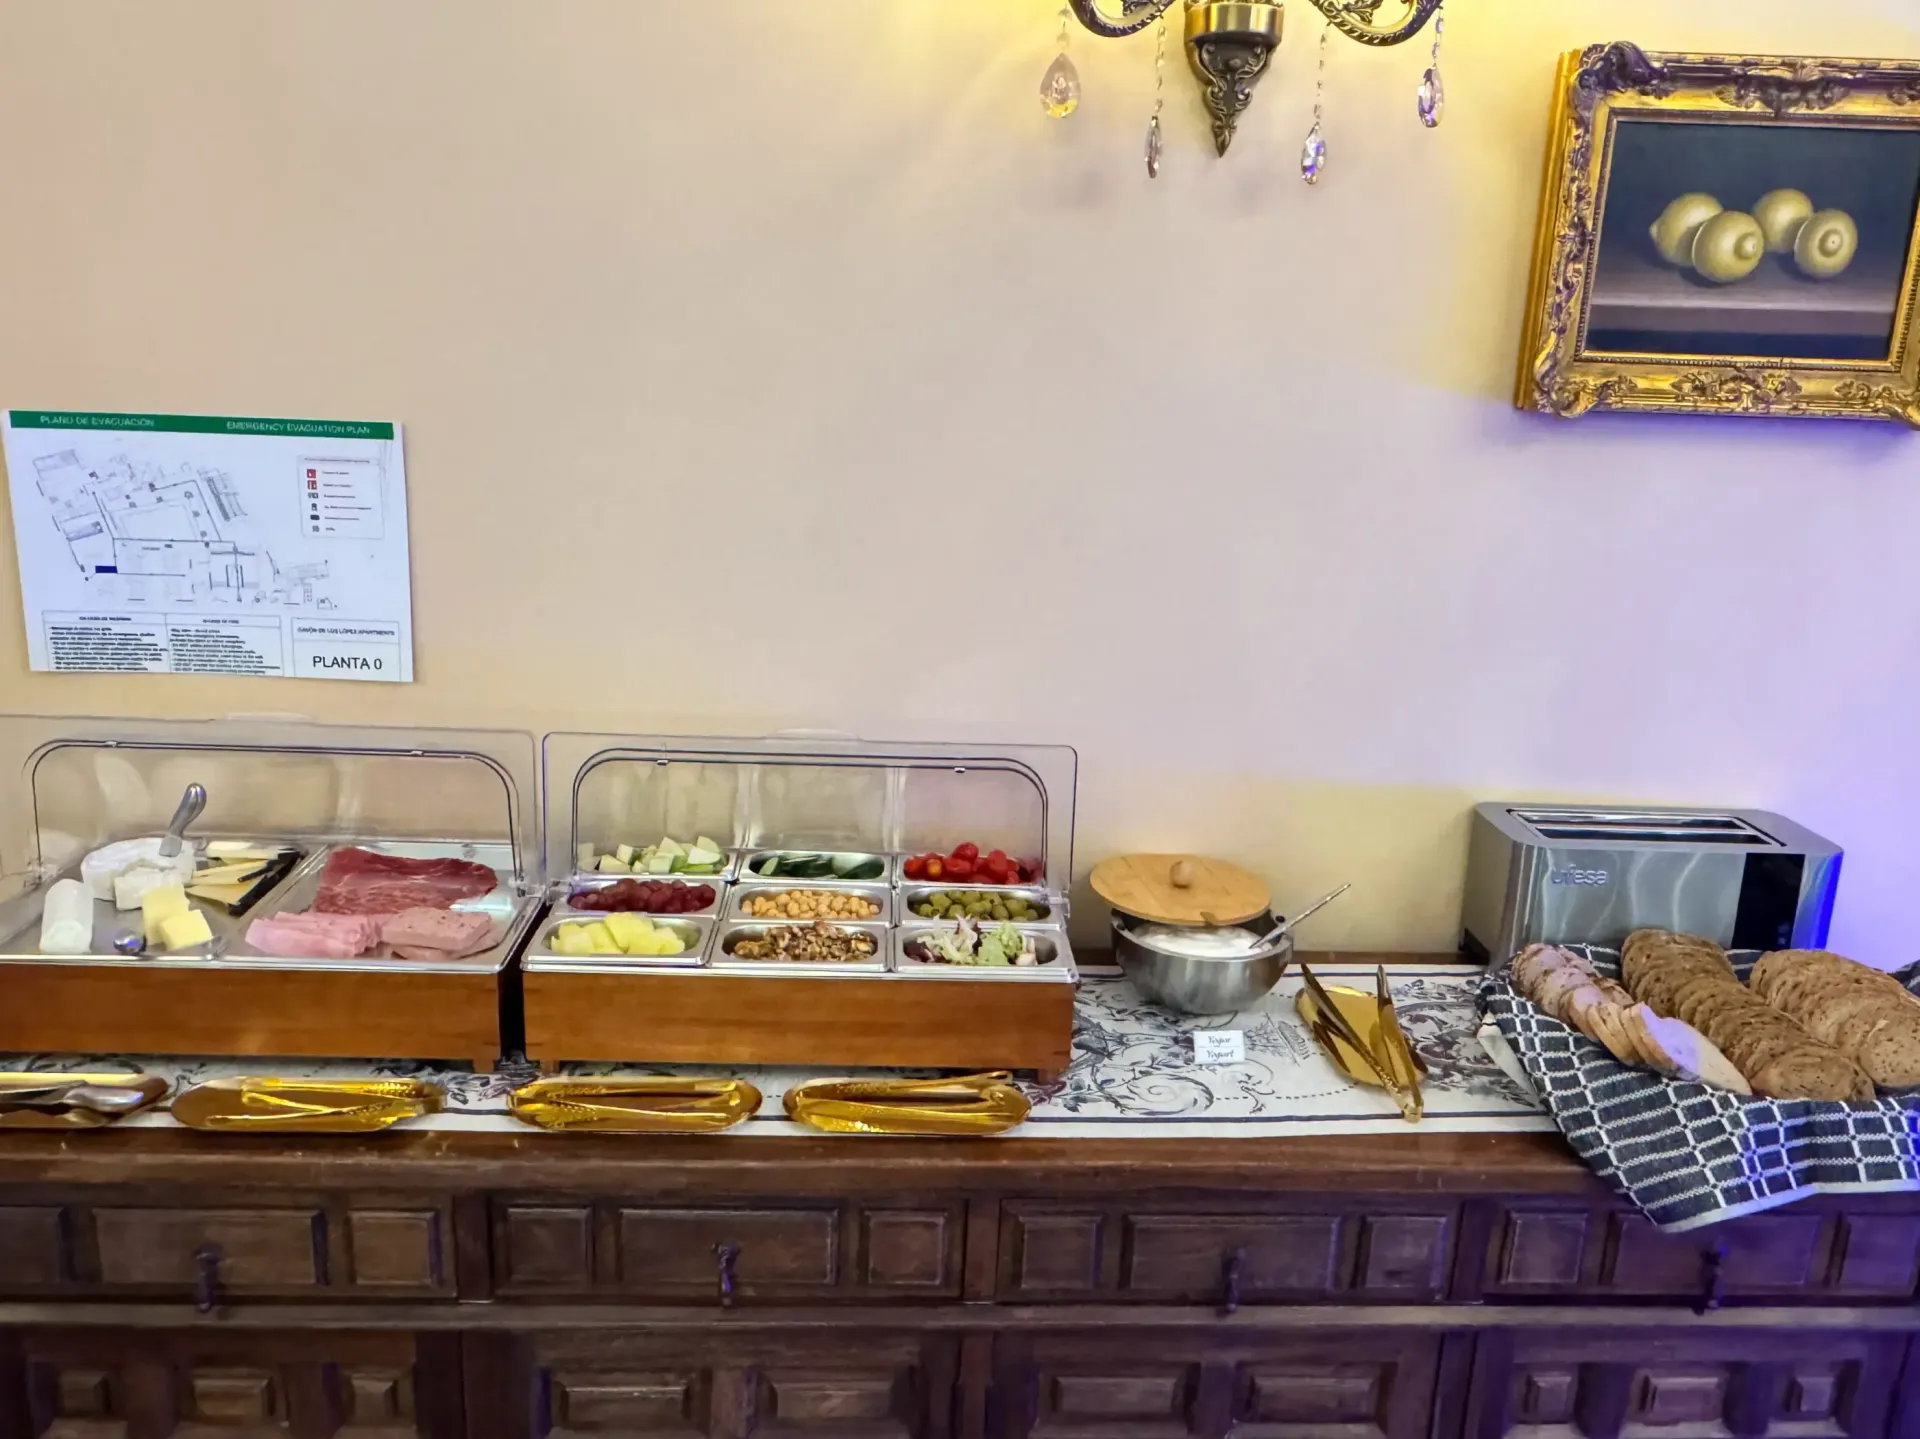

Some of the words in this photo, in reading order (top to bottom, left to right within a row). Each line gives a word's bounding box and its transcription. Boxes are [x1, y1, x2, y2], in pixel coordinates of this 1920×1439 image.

[40, 415, 73, 424] PLANO
[76, 417, 88, 425] DE
[226, 421, 284, 431] EMERGENCY
[286, 423, 345, 433] EVACUATION
[347, 425, 370, 434] PLAN
[313, 656, 370, 670] PLANTA
[1208, 1036, 1231, 1047] Yogur
[1206, 1050, 1234, 1061] Yogurt
